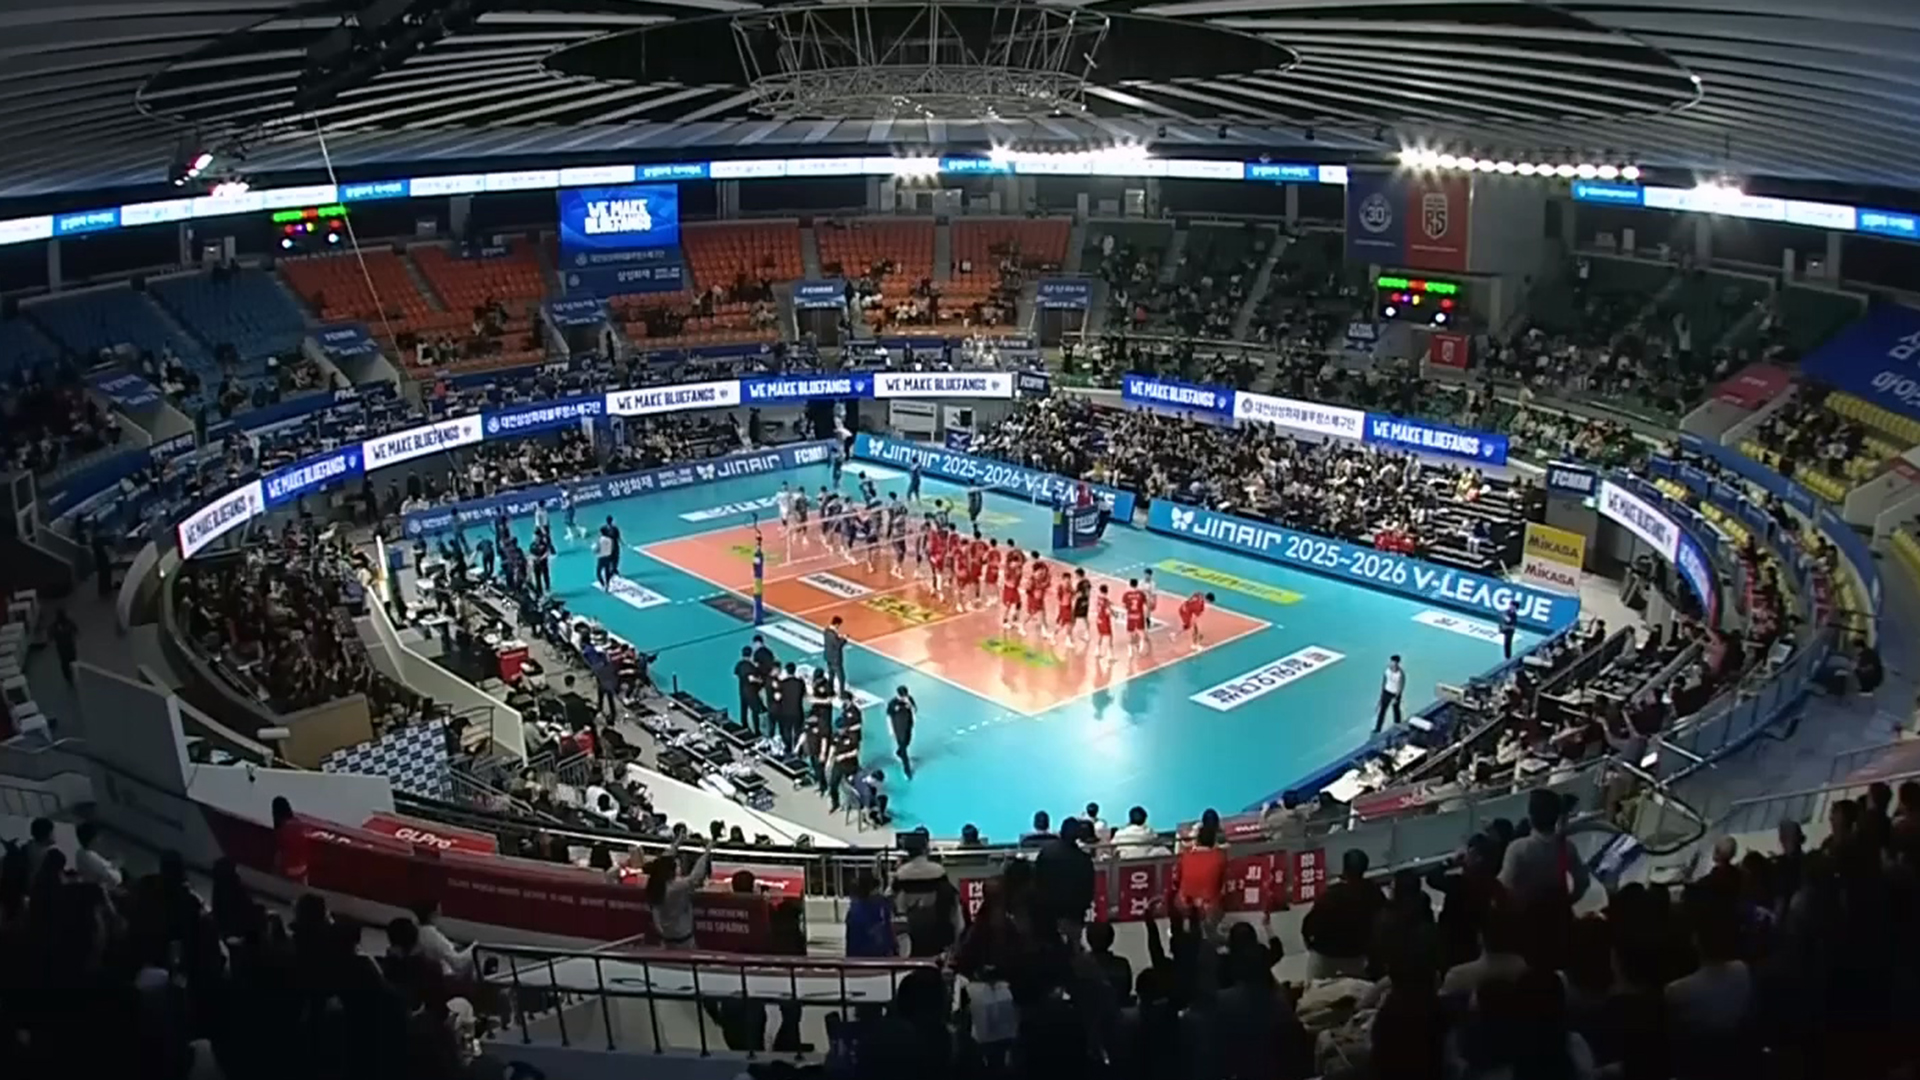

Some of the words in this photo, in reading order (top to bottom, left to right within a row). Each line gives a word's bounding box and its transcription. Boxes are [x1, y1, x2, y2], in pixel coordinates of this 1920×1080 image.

[587, 201, 609, 218] WE
[610, 199, 648, 217] MAKE
[585, 215, 652, 235] BLUEFANGS
[750, 384, 766, 398] WE
[768, 381, 797, 397] MAKE
[798, 379, 851, 395] BLUEFANGS
[886, 380, 901, 391] WE
[904, 379, 933, 391] MAKE
[935, 379, 986, 391] BLUEFANGS
[1130, 380, 1143, 396] WE
[1144, 382, 1170, 399] MAKE
[1169, 385, 1215, 408] BLUEFANGS
[617, 396, 633, 410] WE
[635, 393, 663, 408] MAKE
[664, 388, 715, 406] BLUEFANGS
[373, 445, 387, 460] WE
[388, 436, 413, 455] MAKE
[414, 424, 460, 449] BLUEFANGS
[1373, 420, 1391, 438] WE
[1392, 424, 1420, 443] MAKE
[1422, 427, 1479, 455] BLUEFANGS
[717, 454, 780, 477] JINAIR
[268, 481, 281, 499] WE
[281, 472, 304, 493] MAKE
[304, 456, 346, 486] BLUEFANGS
[608, 474, 654, 497] 삼성화재
[196, 516, 213, 541] MAKE
[213, 496, 247, 530] BLUEFANGS
[1193, 516, 1281, 551] JINAIR
[1412, 566, 1553, 622] V-LEAGUE
